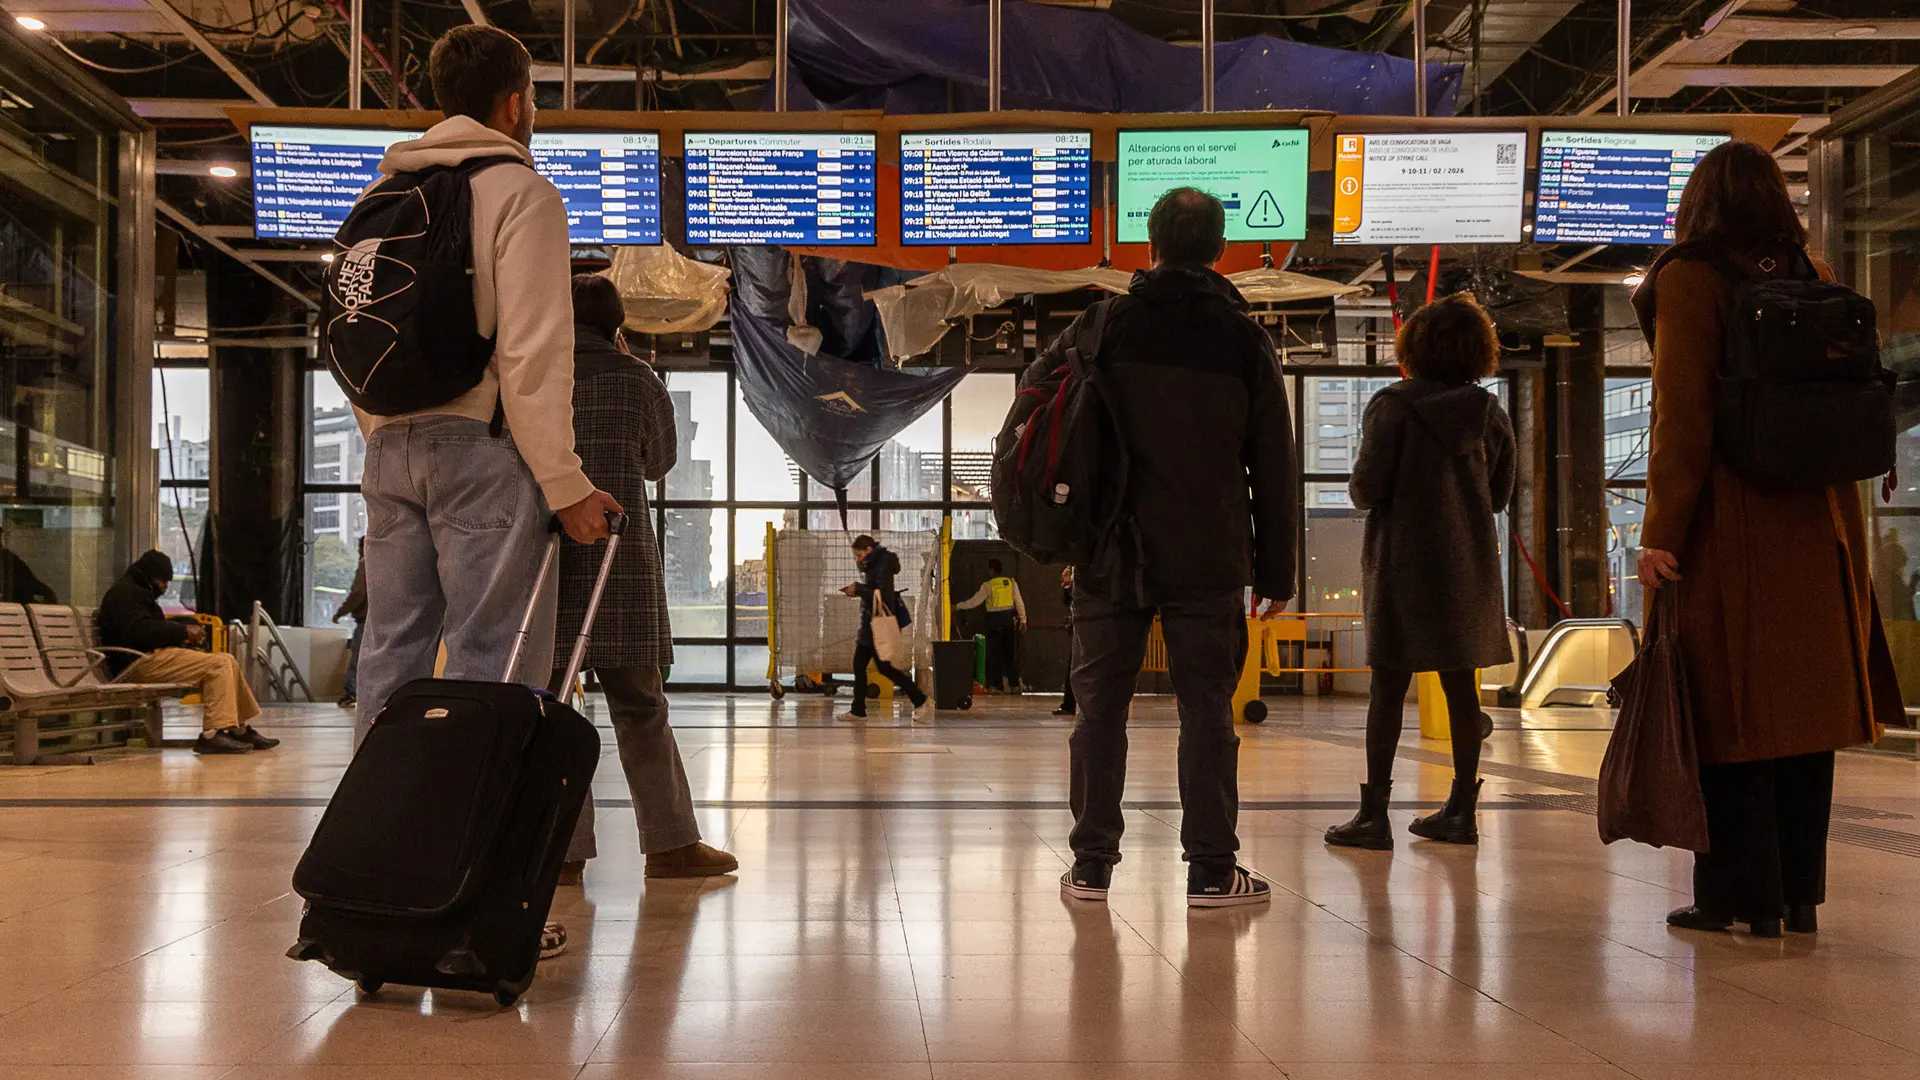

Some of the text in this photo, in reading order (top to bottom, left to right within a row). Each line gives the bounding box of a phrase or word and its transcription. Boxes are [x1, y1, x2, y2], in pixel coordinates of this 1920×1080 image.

[708, 138, 758, 146] Departures
[759, 138, 801, 146] Commuter
[1604, 136, 1636, 146] Regional
[1128, 144, 1181, 153] Alteracions
[1197, 143, 1206, 152] el
[1208, 142, 1236, 152] servei
[331, 159, 362, 167] Llobregat
[1128, 156, 1217, 167] per aturada laboral
[350, 173, 372, 182] França
[717, 217, 754, 225] L'Hospitalet
[764, 217, 795, 226] Llobregat
[782, 231, 804, 239] França
[1629, 230, 1651, 238] França
[338, 261, 356, 292] THE
[358, 259, 375, 304] FACE
